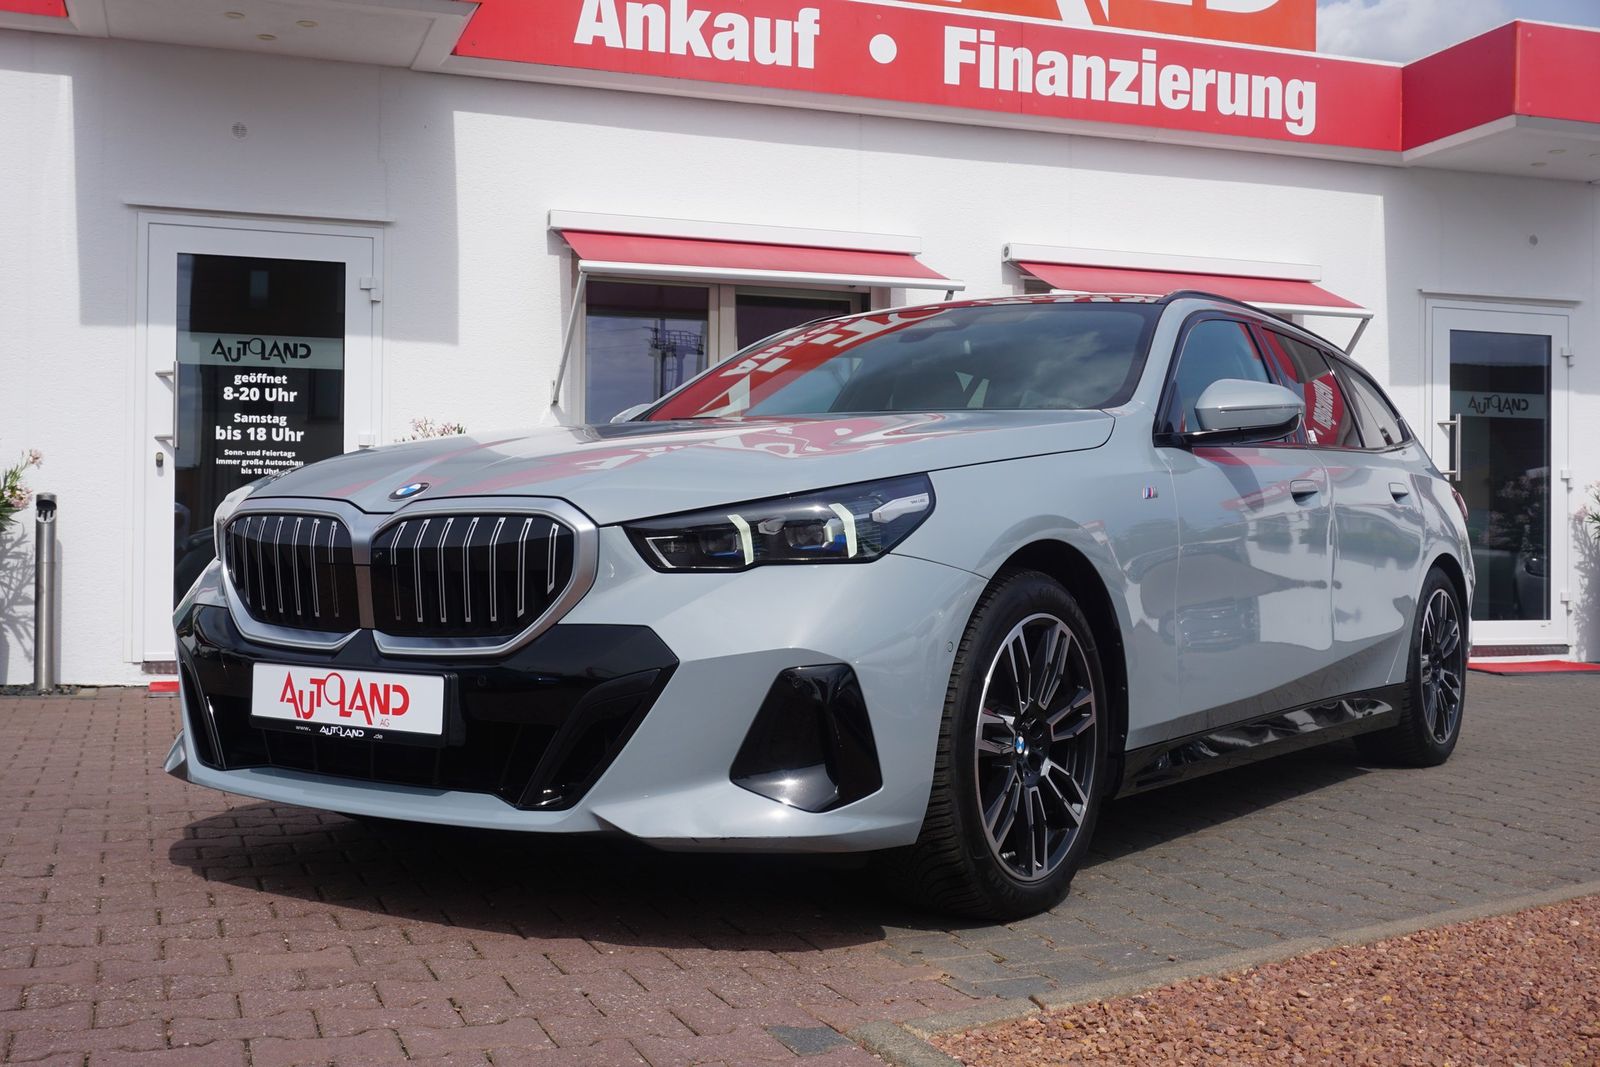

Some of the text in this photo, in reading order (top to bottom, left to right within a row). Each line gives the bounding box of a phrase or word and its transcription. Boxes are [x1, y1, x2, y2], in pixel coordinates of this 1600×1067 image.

[573, 0, 1317, 136] Ankauf Finanzierung
[211, 337, 311, 364] AUTOLAND
[233, 372, 288, 385] geöffnet
[223, 386, 298, 402] 8-20 Uhr
[1468, 394, 1529, 415] AUTOLAND
[233, 412, 288, 426] Samstag
[215, 425, 304, 442] bis 18 Uhr
[223, 448, 296, 459] Sonn- und Feiertags
[241, 458, 264, 467] große
[264, 459, 304, 468] Autoschau
[240, 467, 252, 475] bis
[253, 467, 262, 475] 18
[279, 671, 410, 726] AUTOLAND
[380, 718, 391, 728] AG
[319, 725, 365, 739] AUTOLAND
